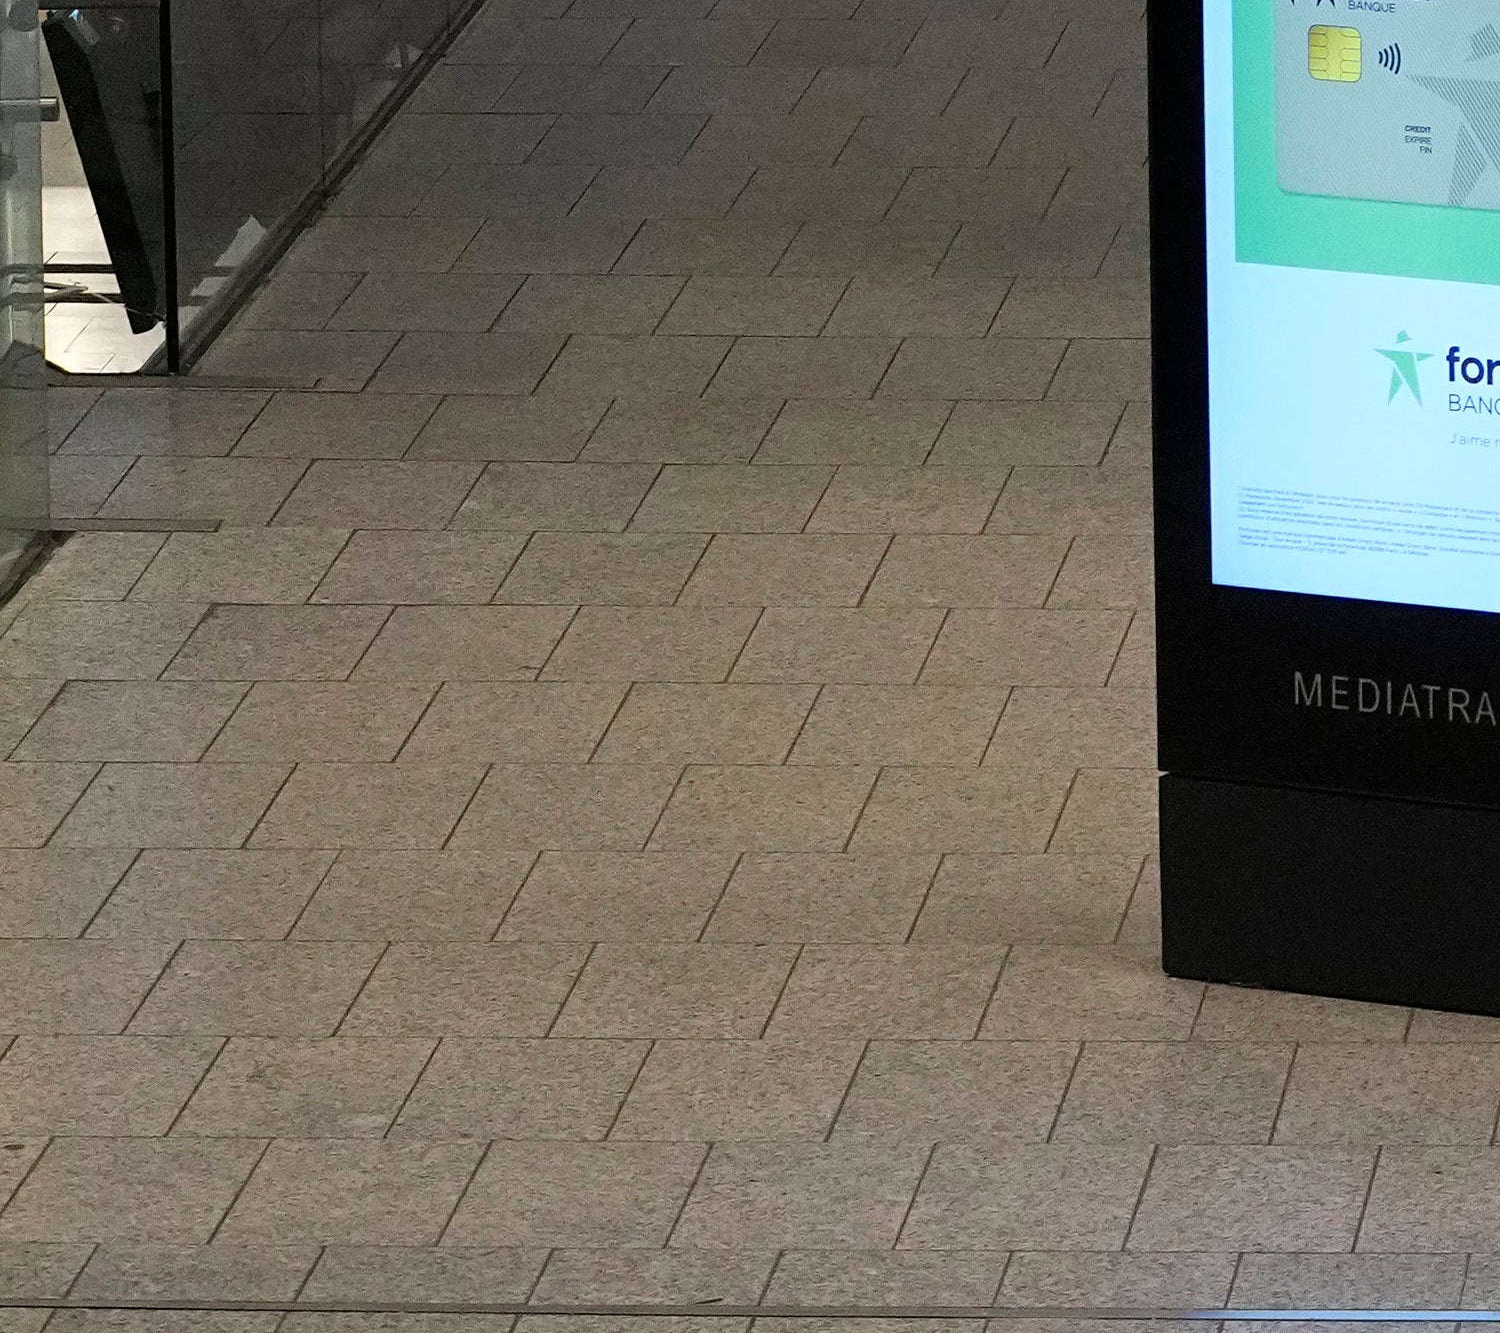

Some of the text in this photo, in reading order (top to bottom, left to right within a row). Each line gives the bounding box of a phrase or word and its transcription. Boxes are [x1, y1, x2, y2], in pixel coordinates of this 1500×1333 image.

[1348, 0, 1397, 14] BANQUE
[1404, 124, 1432, 134] CREDIT
[1404, 135, 1432, 146] EXPIRE
